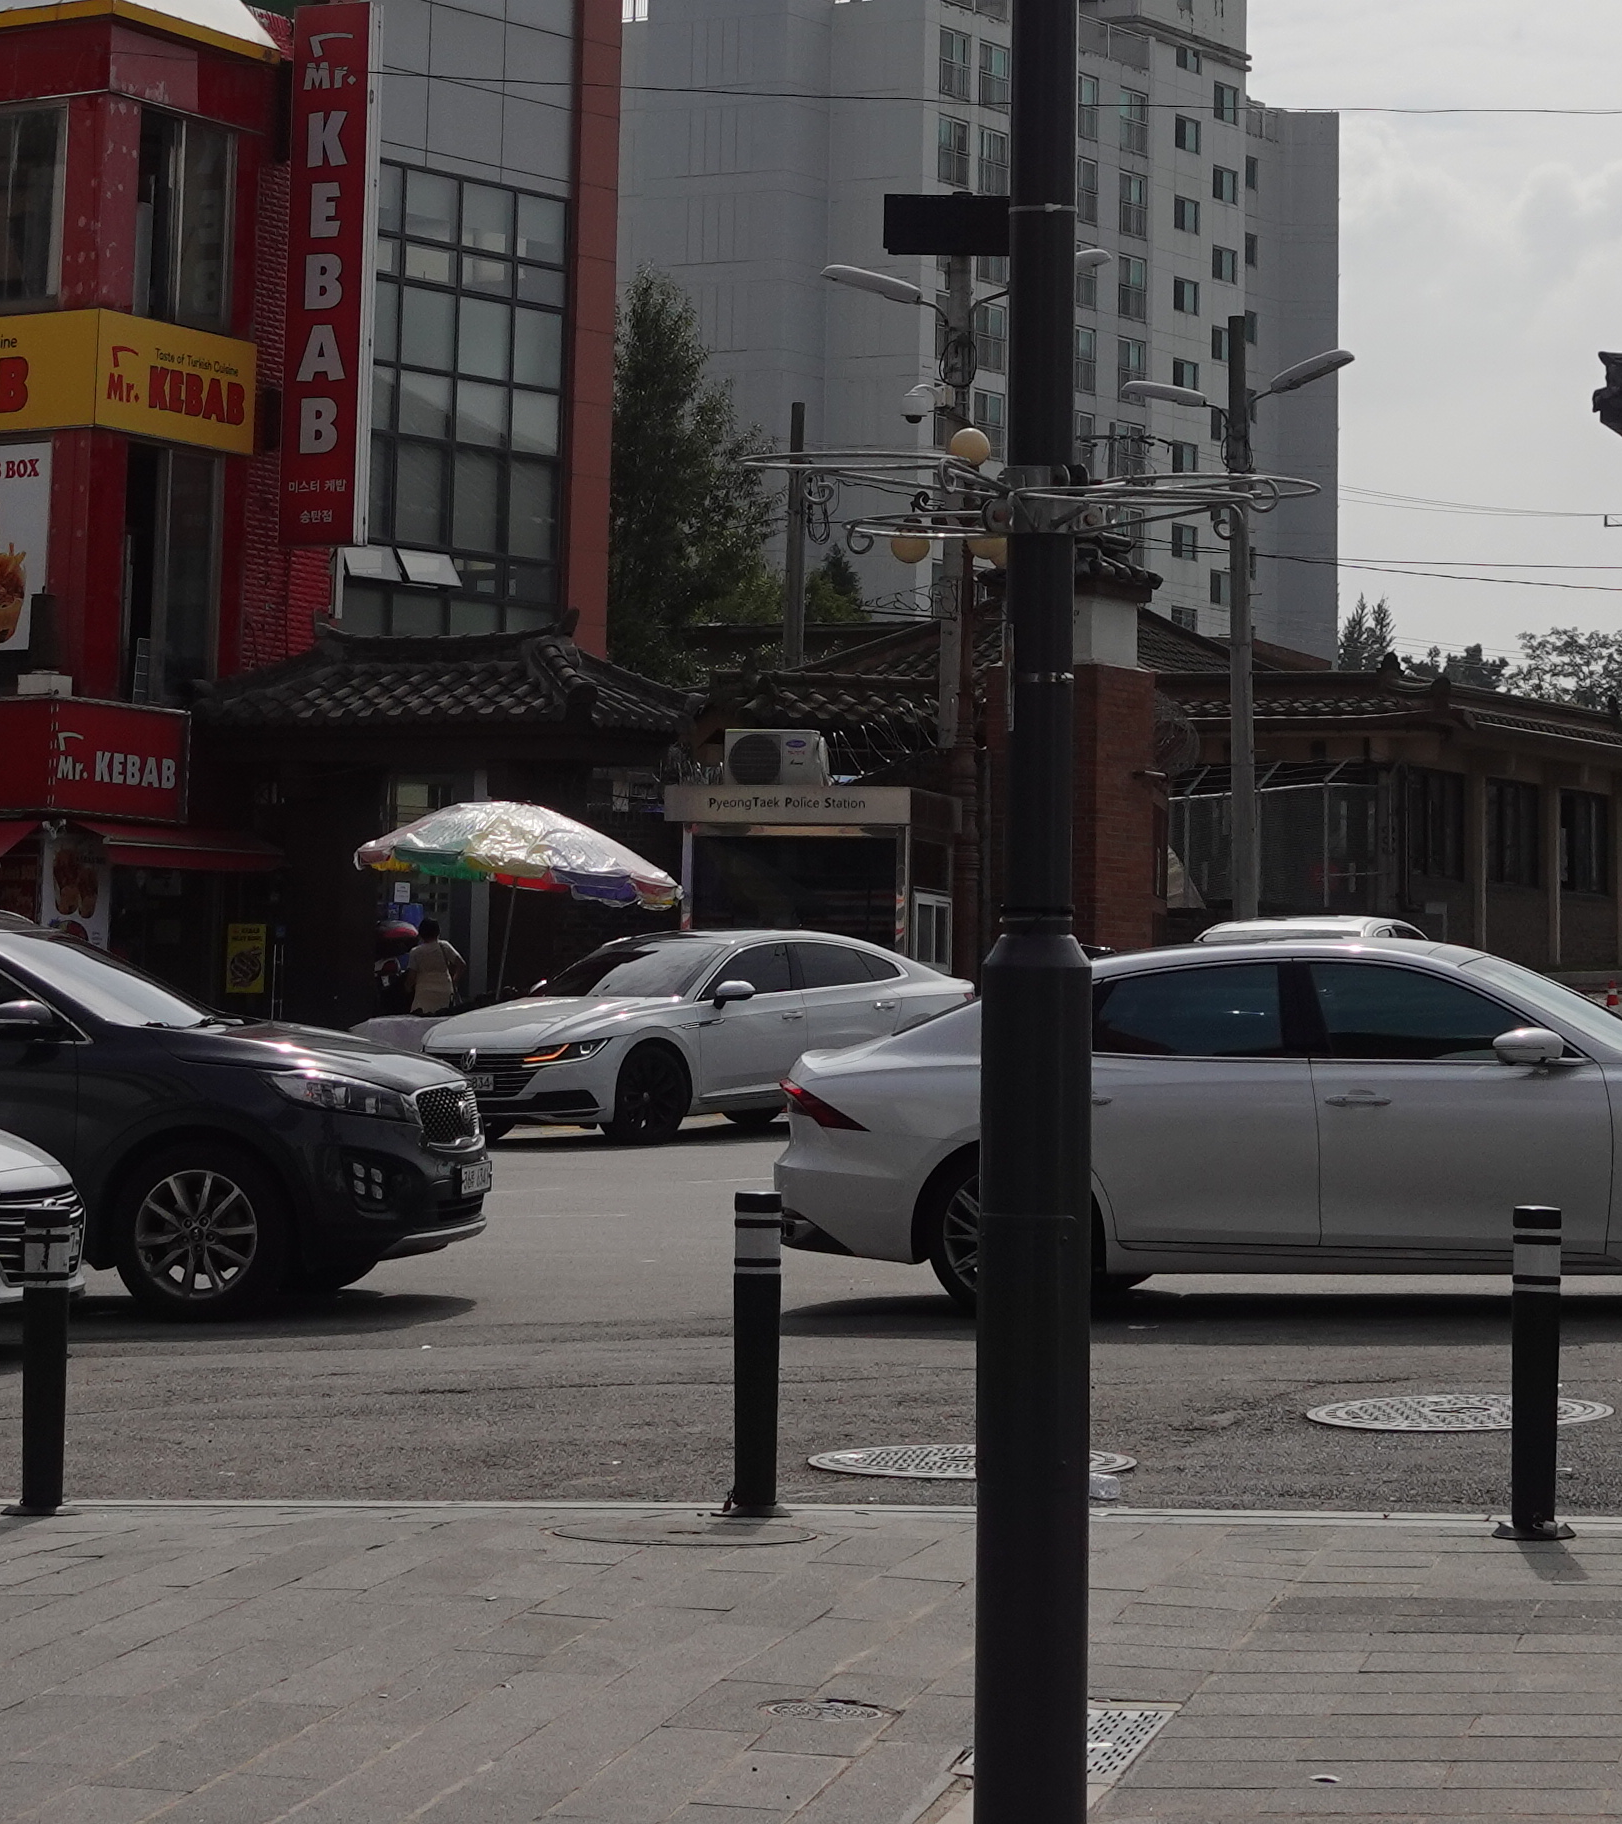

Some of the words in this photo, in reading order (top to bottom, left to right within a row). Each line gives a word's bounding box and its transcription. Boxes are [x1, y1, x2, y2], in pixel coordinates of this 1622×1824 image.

[303, 62, 357, 91] Mr.
[295, 110, 348, 455] KEBAB
[154, 347, 175, 364] Taste
[186, 354, 212, 372] Turkish
[213, 361, 240, 378] Cuisine
[107, 373, 140, 403] Mr.
[148, 365, 245, 426] KEBAB
[5, 458, 40, 479] BOX
[288, 480, 320, 493] 미스터
[57, 755, 88, 781] Mr.
[94, 750, 177, 790] KEBAB
[709, 797, 780, 811] PyeongTaek
[785, 797, 820, 808] Police
[824, 797, 866, 808] Station
